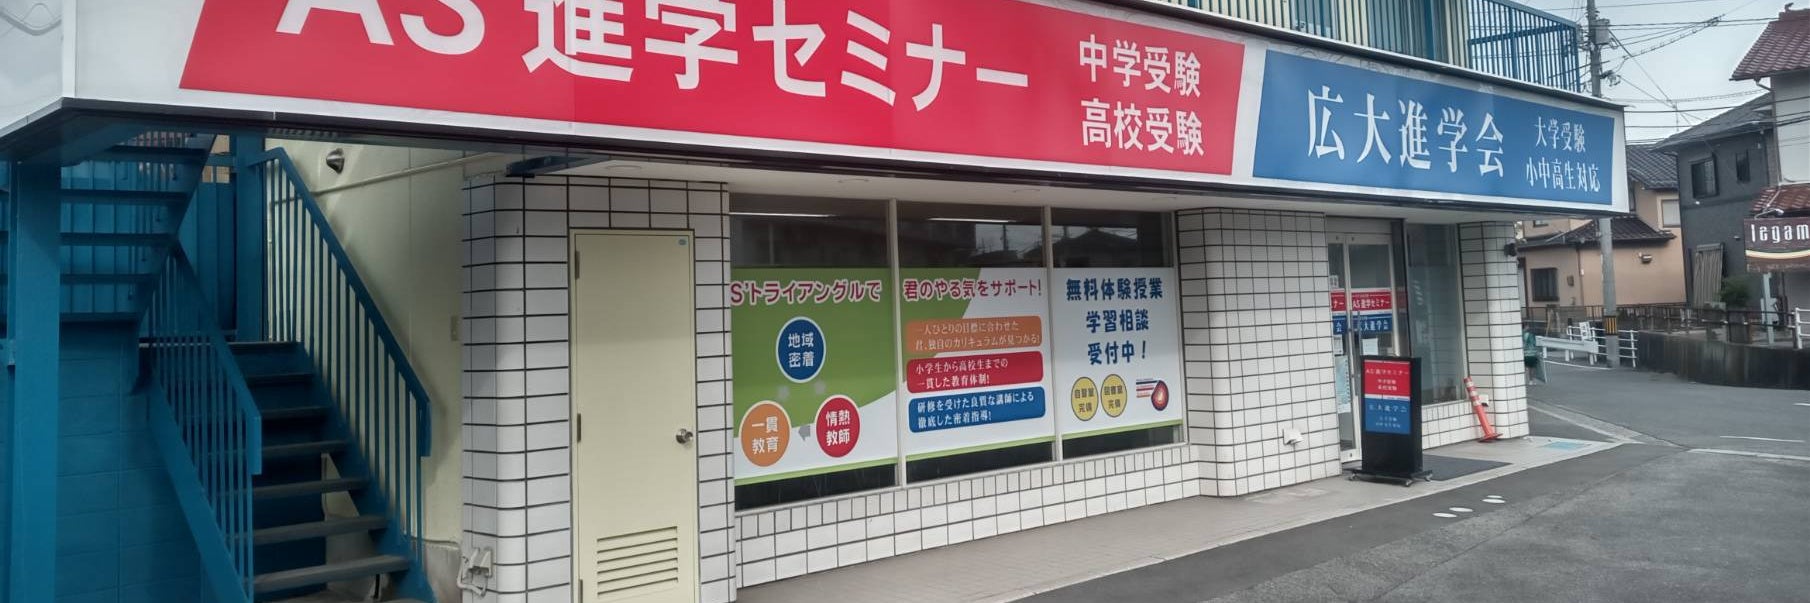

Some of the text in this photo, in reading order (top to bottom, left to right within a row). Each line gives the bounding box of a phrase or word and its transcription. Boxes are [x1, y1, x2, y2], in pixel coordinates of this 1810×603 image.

[1078, 34, 1202, 98] 中学受験
[1080, 97, 1204, 157] 高校受験
[1308, 85, 1504, 178] 広大進学会
[1534, 117, 1586, 154] 大学受験
[1525, 157, 1601, 193] 小中高生対応
[904, 278, 1042, 300] 君のやる気をサポート!
[1066, 277, 1163, 301] 無料体験授業
[1086, 308, 1149, 333] 学習相談
[788, 332, 814, 348] 地域
[788, 351, 814, 368] 密着
[1087, 340, 1146, 365] 受付中！
[916, 358, 1009, 375] 小学生から高校生までの
[752, 416, 778, 432] 一貫
[825, 410, 850, 426] 情熱
[752, 437, 779, 454] 教育
[826, 430, 850, 446] 教師
